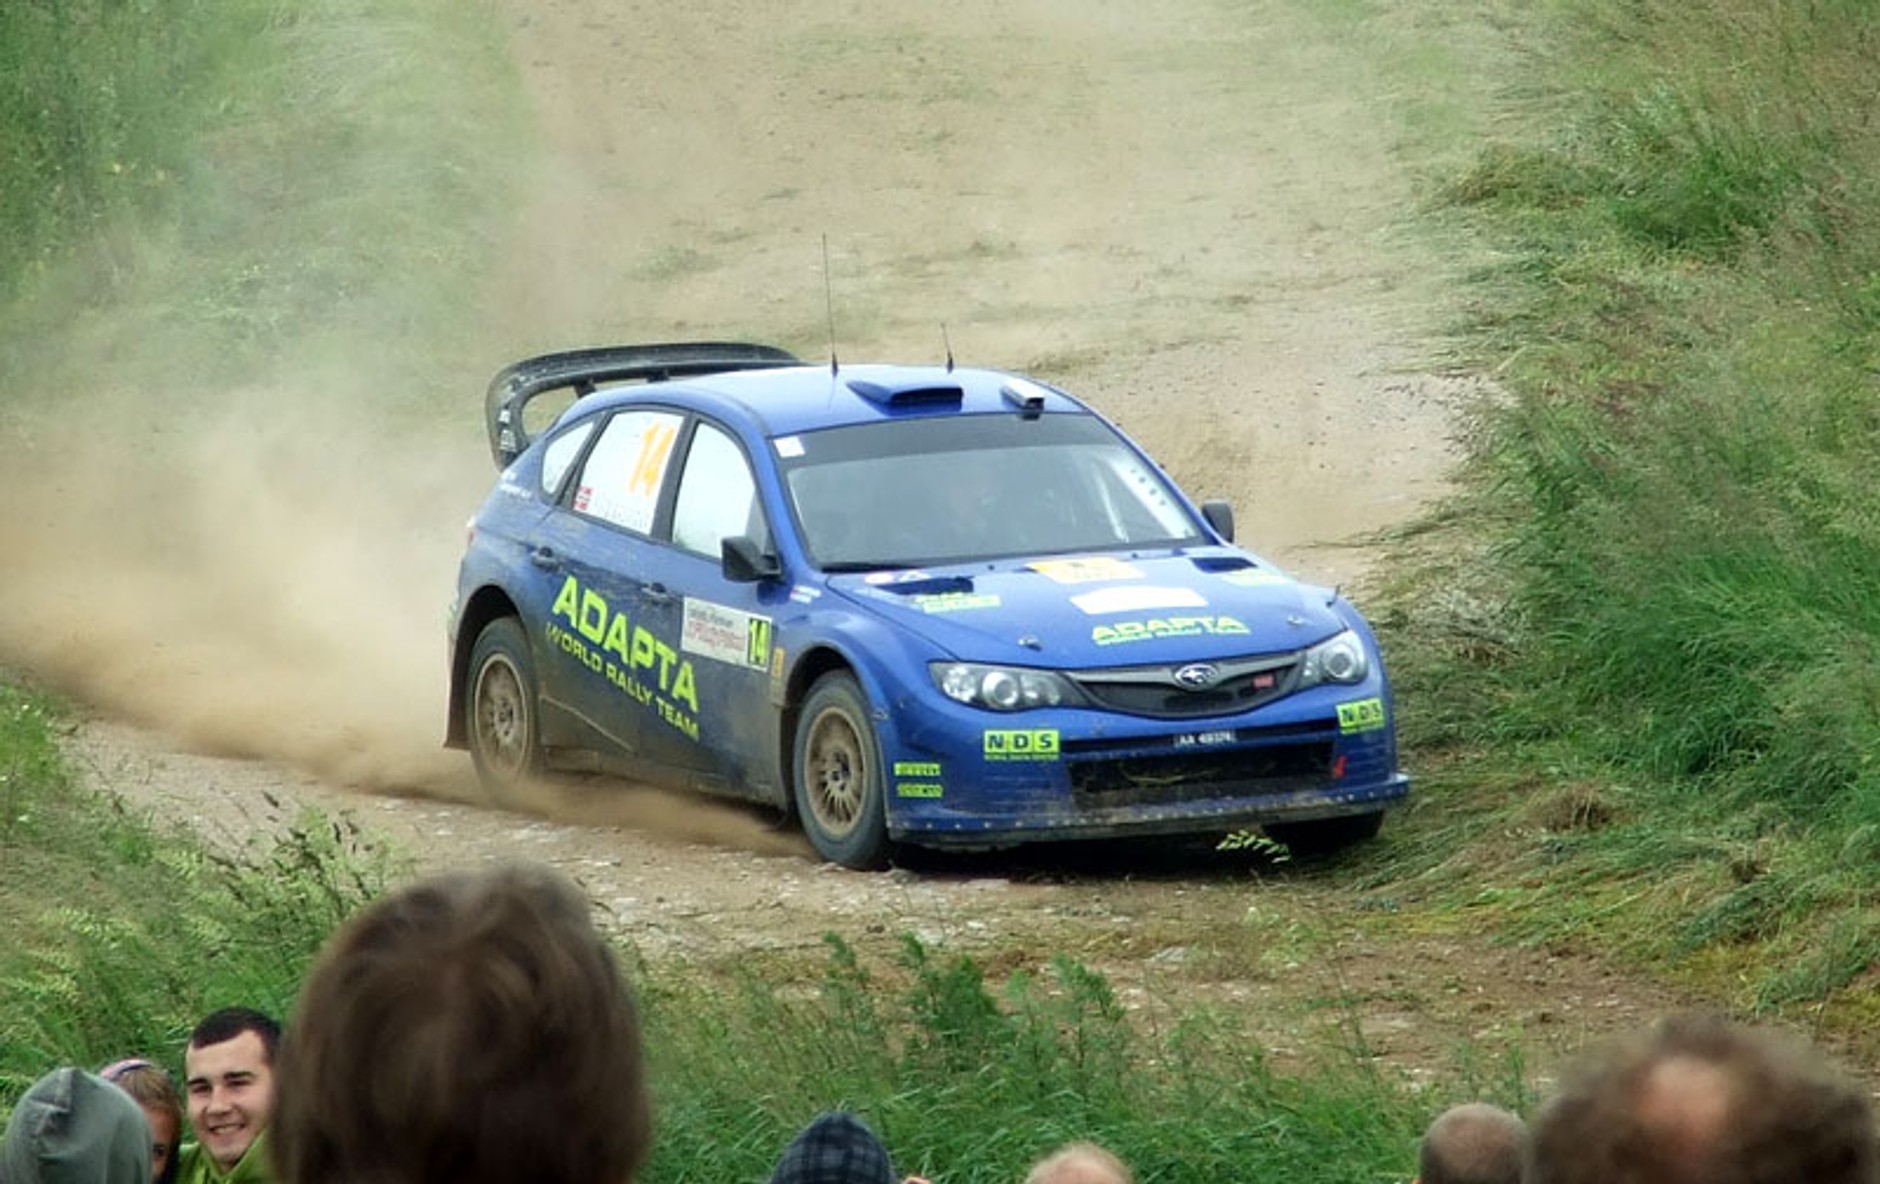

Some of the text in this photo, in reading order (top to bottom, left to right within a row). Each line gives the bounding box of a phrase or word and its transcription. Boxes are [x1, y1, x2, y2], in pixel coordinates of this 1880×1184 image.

[628, 420, 676, 498] 14
[552, 574, 699, 713] ADAPTA
[748, 618, 768, 666] 14
[1092, 616, 1252, 641] ADAPTA
[544, 620, 700, 743] WORLD RALLY TEAM
[1341, 701, 1381, 723] NDS
[988, 733, 1052, 750] NDS
